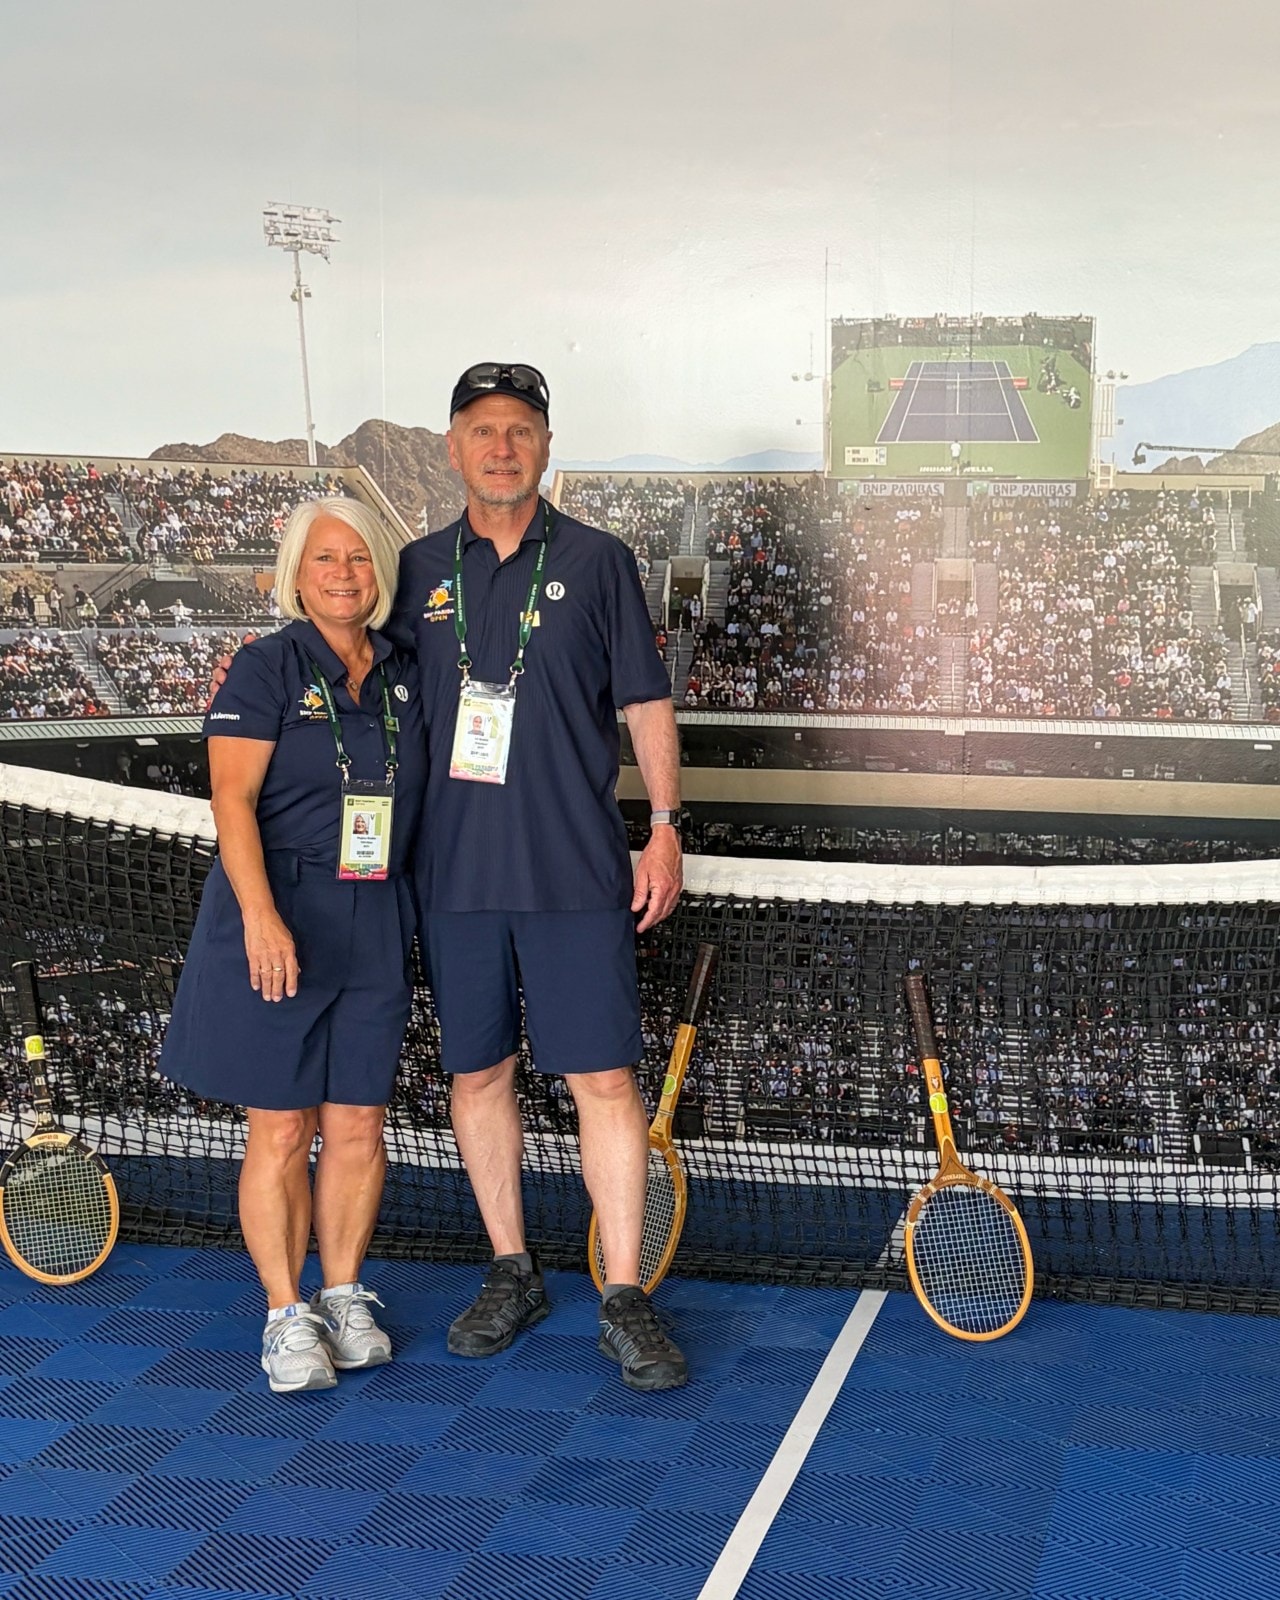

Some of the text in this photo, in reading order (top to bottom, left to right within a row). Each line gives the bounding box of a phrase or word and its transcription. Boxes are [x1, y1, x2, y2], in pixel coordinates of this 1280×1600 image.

[863, 484, 940, 494] BNP PARIBAS
[993, 484, 1072, 495] BNP PARIBAS
[430, 614, 448, 622] OPEN
